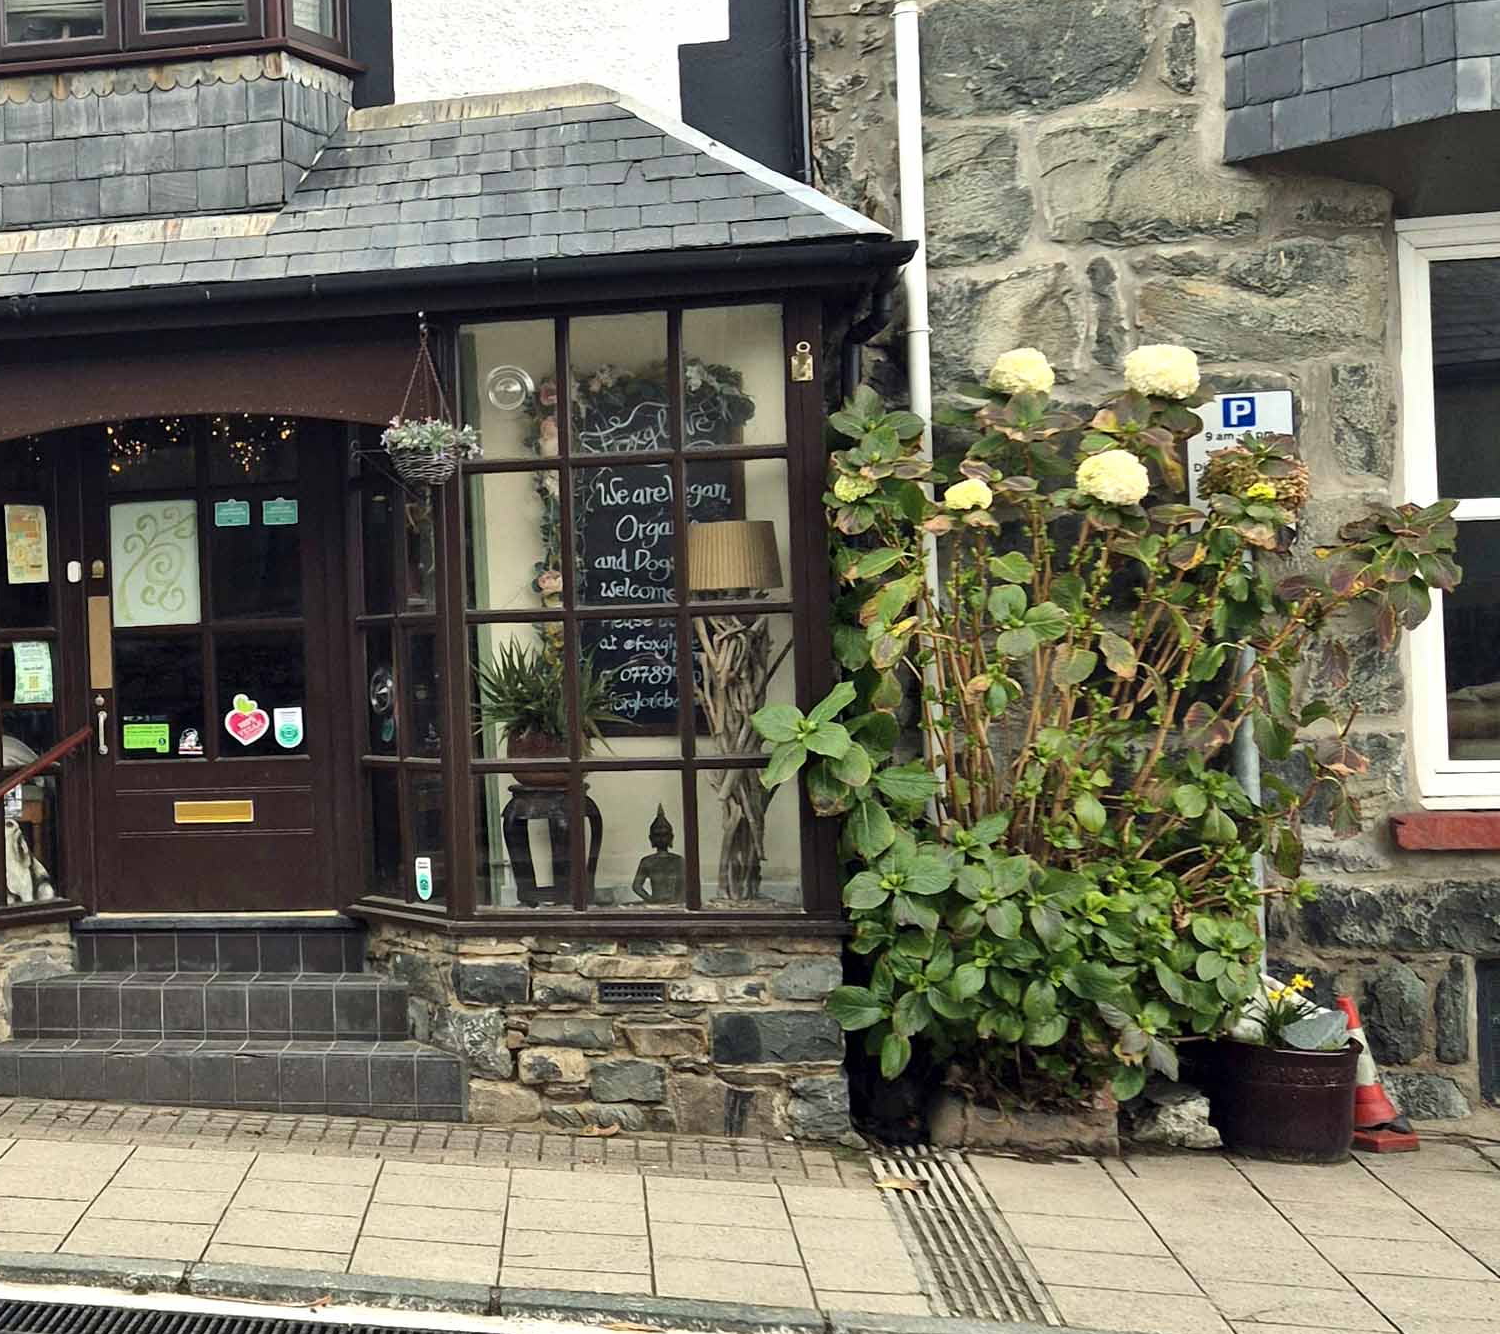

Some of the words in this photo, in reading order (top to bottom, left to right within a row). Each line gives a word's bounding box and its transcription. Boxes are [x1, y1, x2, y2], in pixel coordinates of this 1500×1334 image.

[1230, 400, 1252, 425] P
[1205, 431, 1213, 441] 9
[1216, 432, 1235, 440] am
[596, 477, 630, 505] We
[595, 548, 632, 572] and
